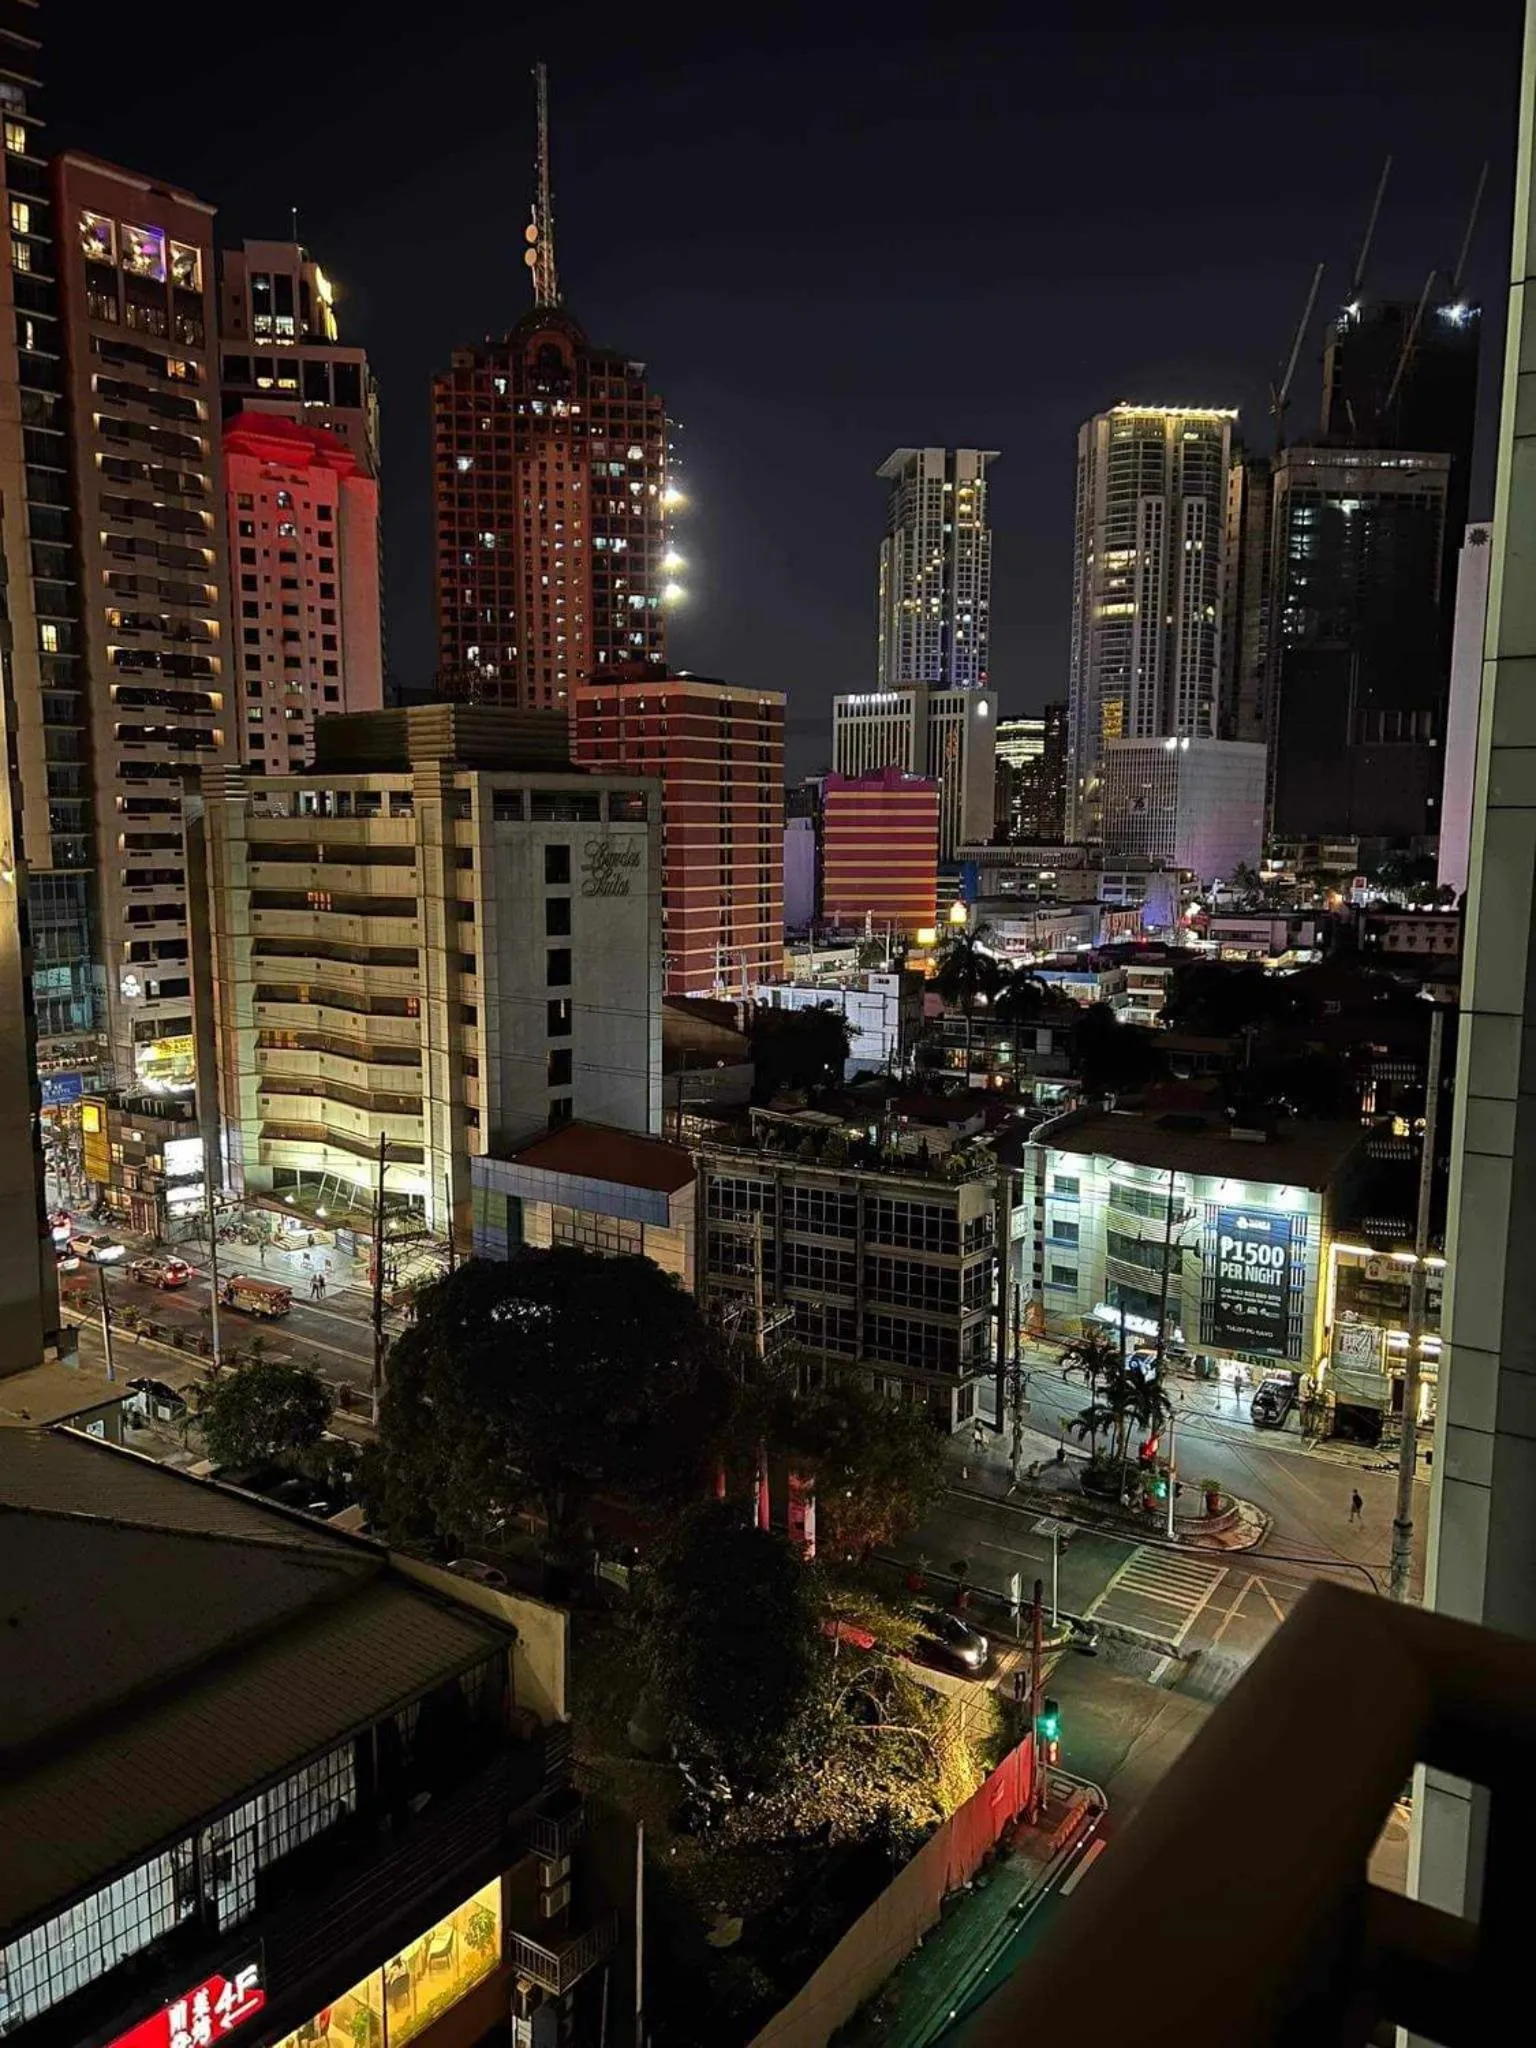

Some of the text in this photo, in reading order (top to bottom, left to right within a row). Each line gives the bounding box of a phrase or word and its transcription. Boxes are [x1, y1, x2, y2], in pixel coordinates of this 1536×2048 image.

[1221, 1261, 1284, 1286] PER NIGHT
[215, 1963, 258, 2014] 4F
